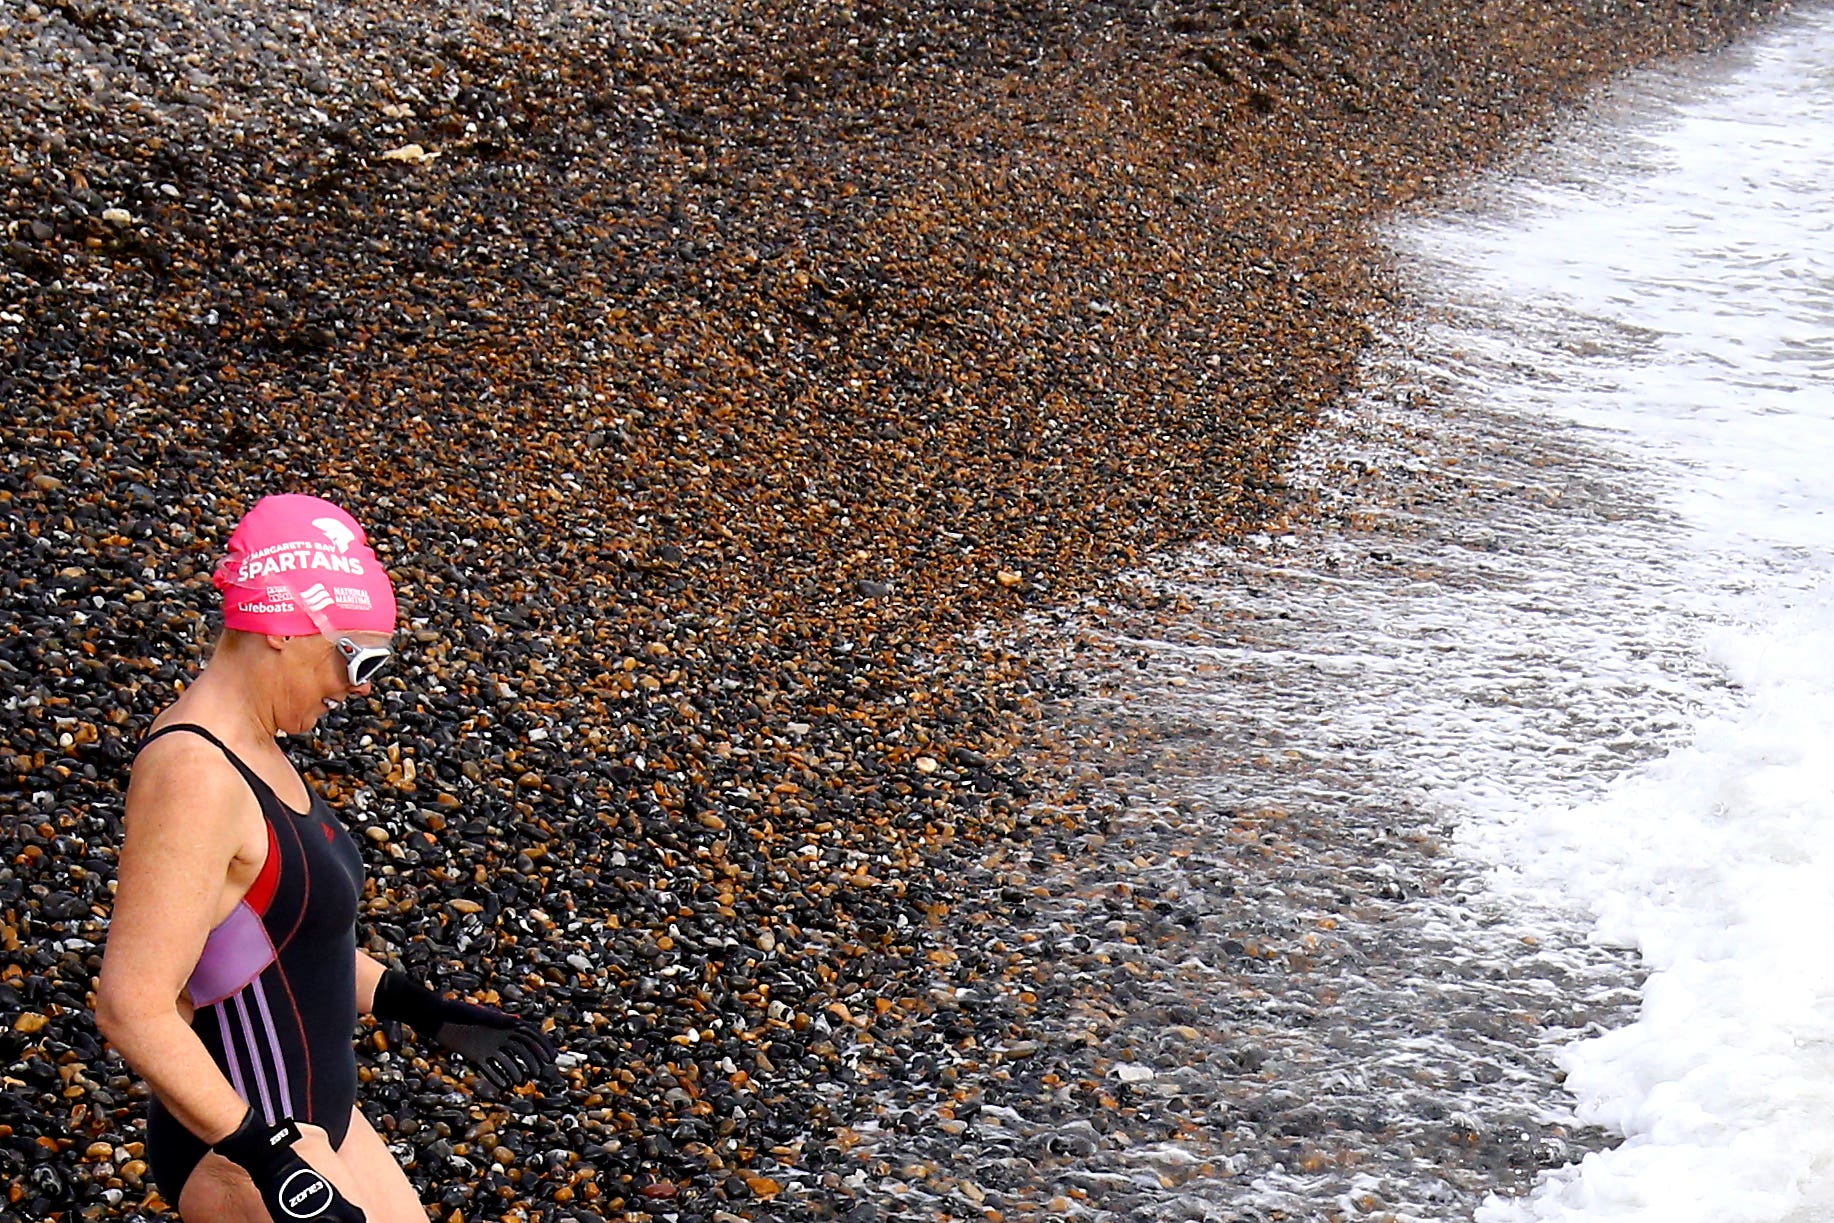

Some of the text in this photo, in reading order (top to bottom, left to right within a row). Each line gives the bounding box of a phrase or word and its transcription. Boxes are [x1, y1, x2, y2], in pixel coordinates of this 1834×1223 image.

[314, 542, 336, 553] BAY
[237, 550, 365, 582] SPARTANS
[238, 602, 295, 614] Lifeboats
